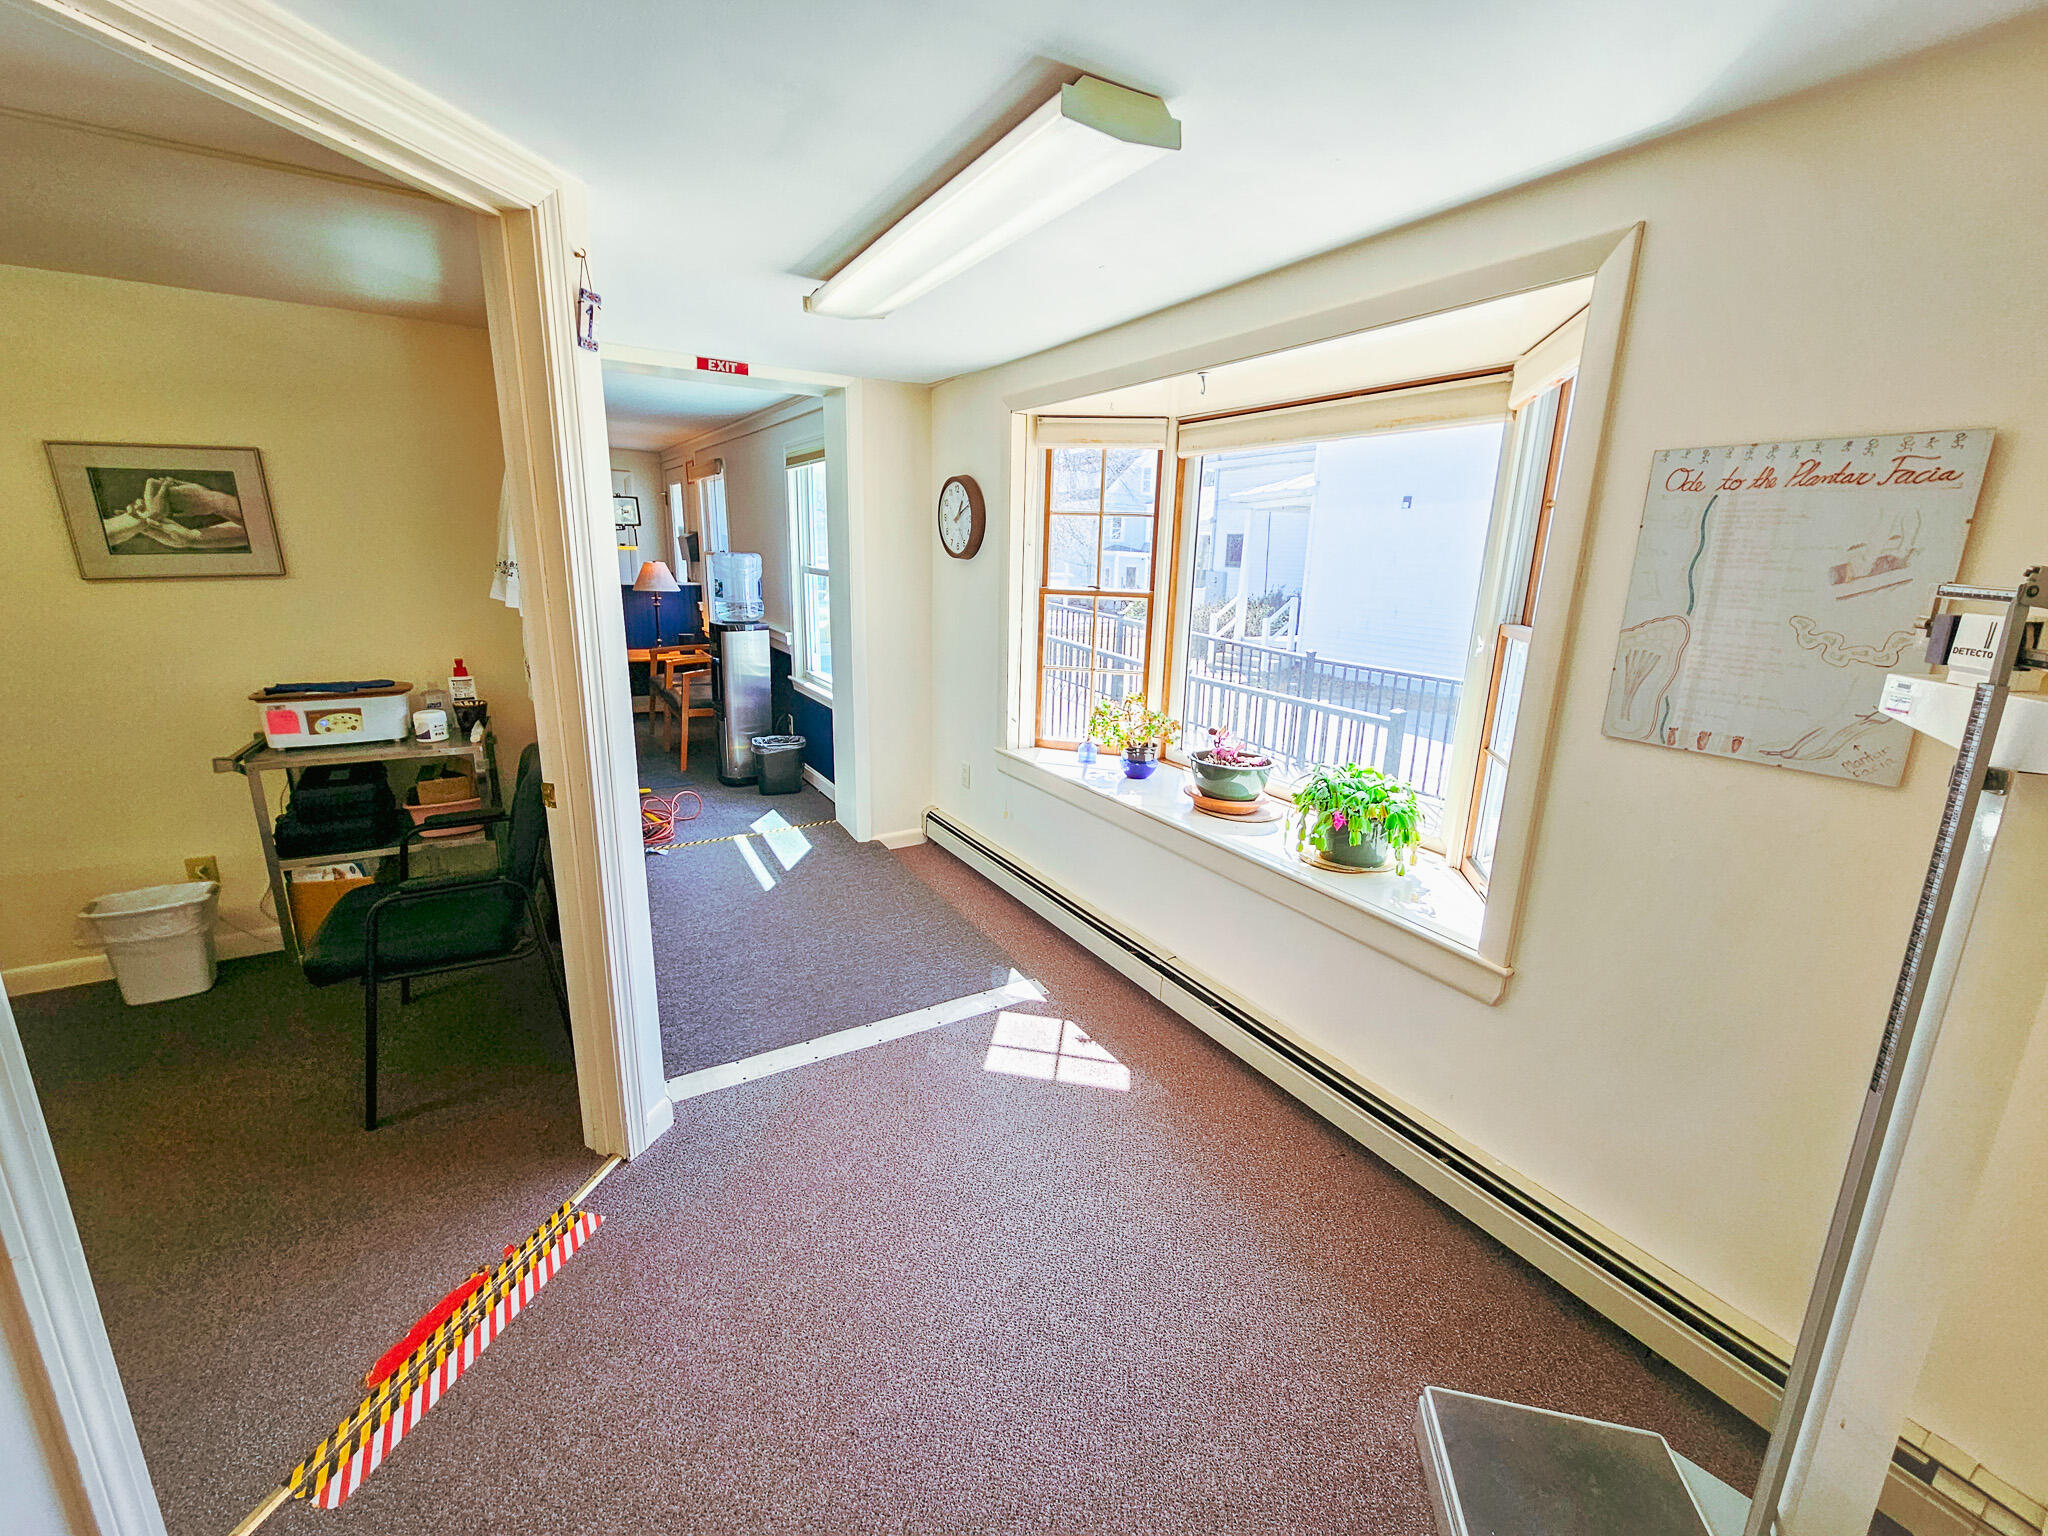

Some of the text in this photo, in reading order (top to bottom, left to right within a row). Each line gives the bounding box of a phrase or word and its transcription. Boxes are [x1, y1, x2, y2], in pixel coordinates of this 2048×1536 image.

[707, 359, 738, 373] EXIT
[1665, 455, 1964, 492] Ode to the Plantar Facia
[1952, 646, 1994, 659] DETECTO
